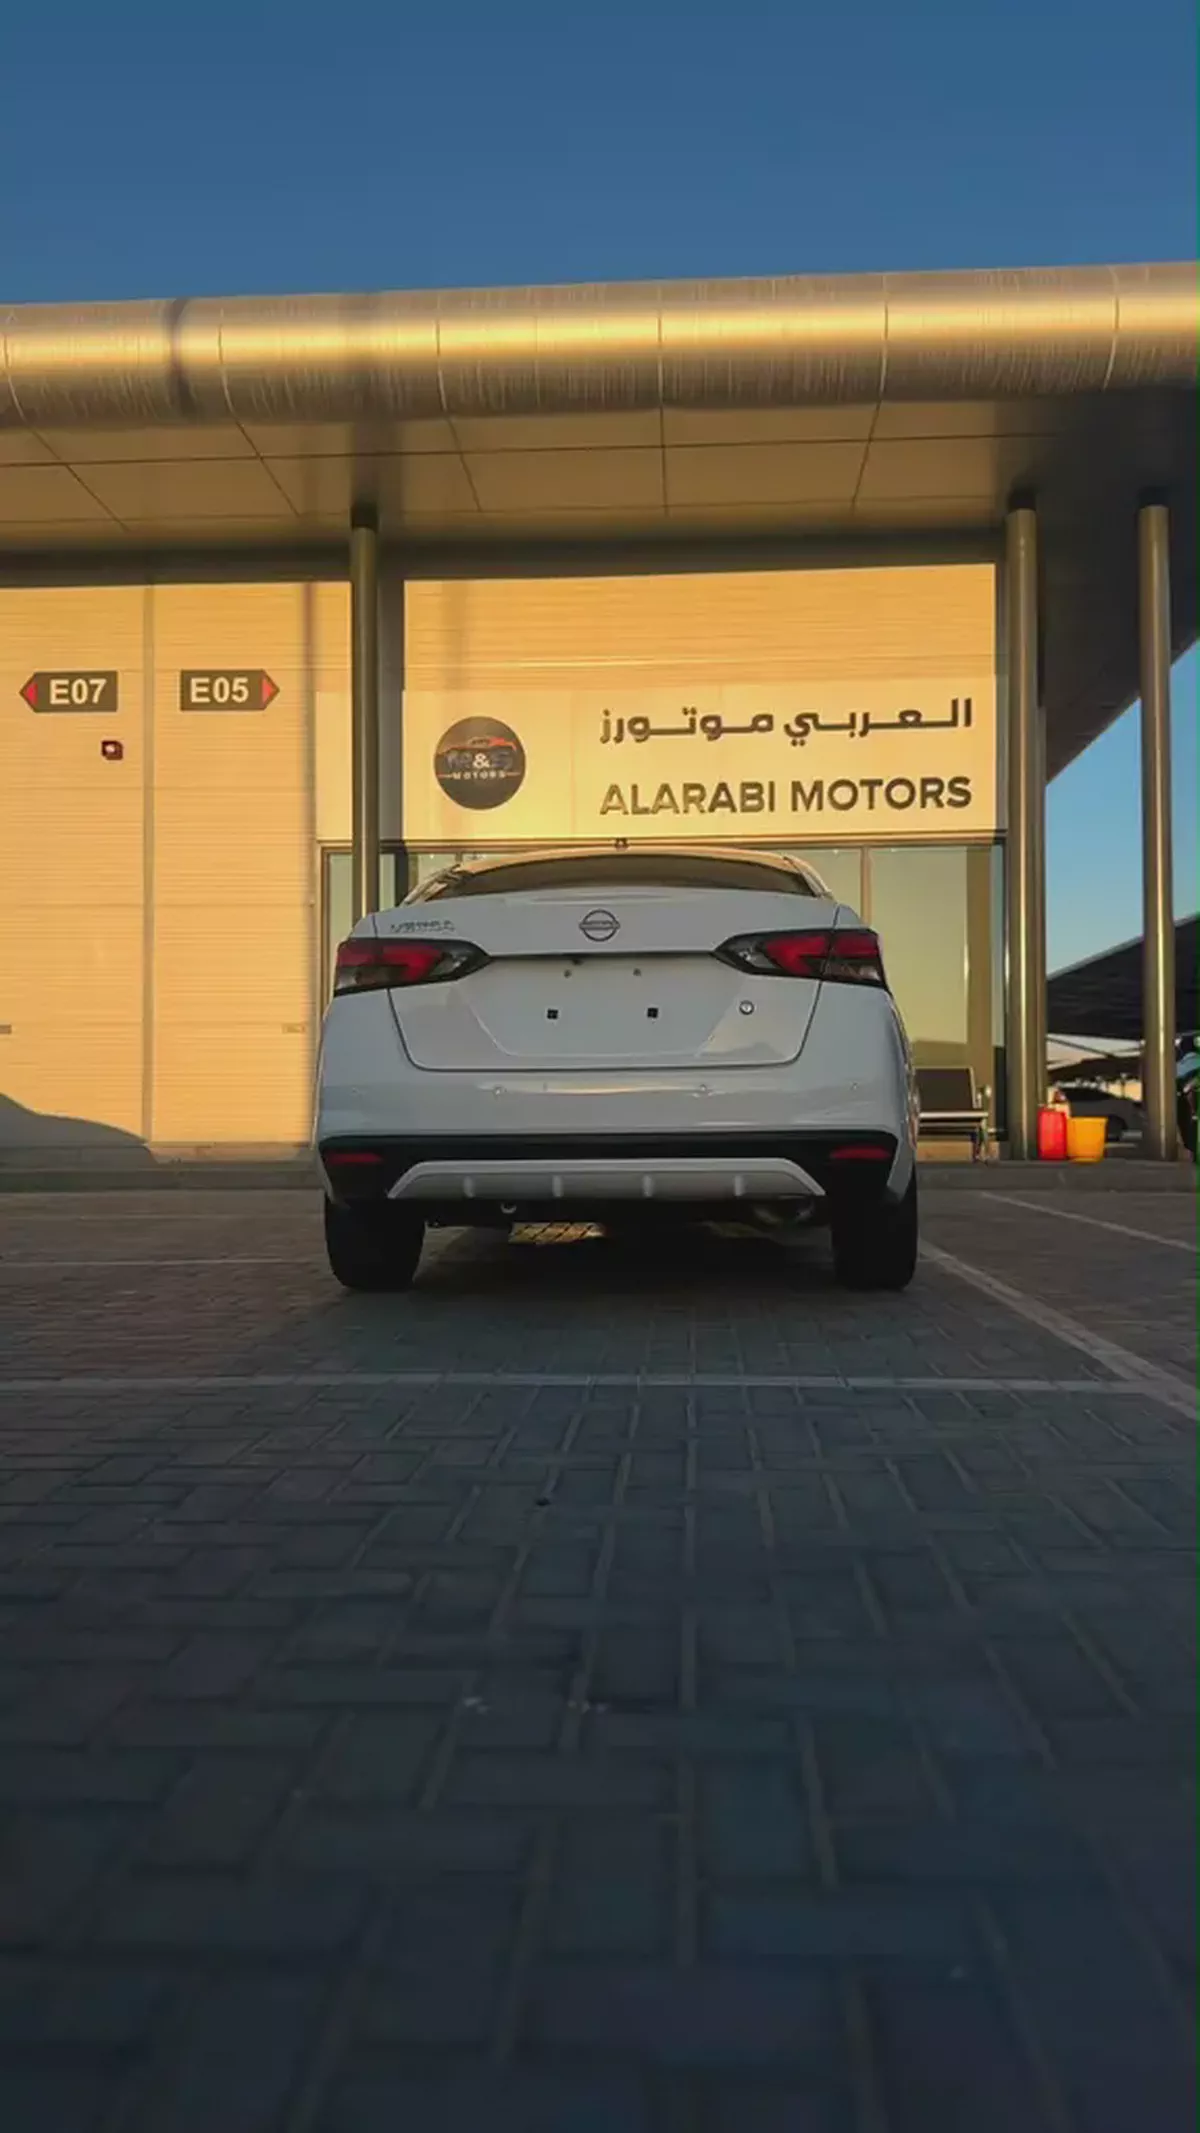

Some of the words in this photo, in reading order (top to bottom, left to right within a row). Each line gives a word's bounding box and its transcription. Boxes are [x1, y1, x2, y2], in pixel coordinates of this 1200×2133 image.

[50, 678, 107, 704] E07
[190, 677, 249, 703] E05
[600, 706, 774, 743] موتورز
[784, 697, 973, 747] العربي
[600, 781, 776, 815] ALARABI
[790, 776, 973, 812] MOTORS
